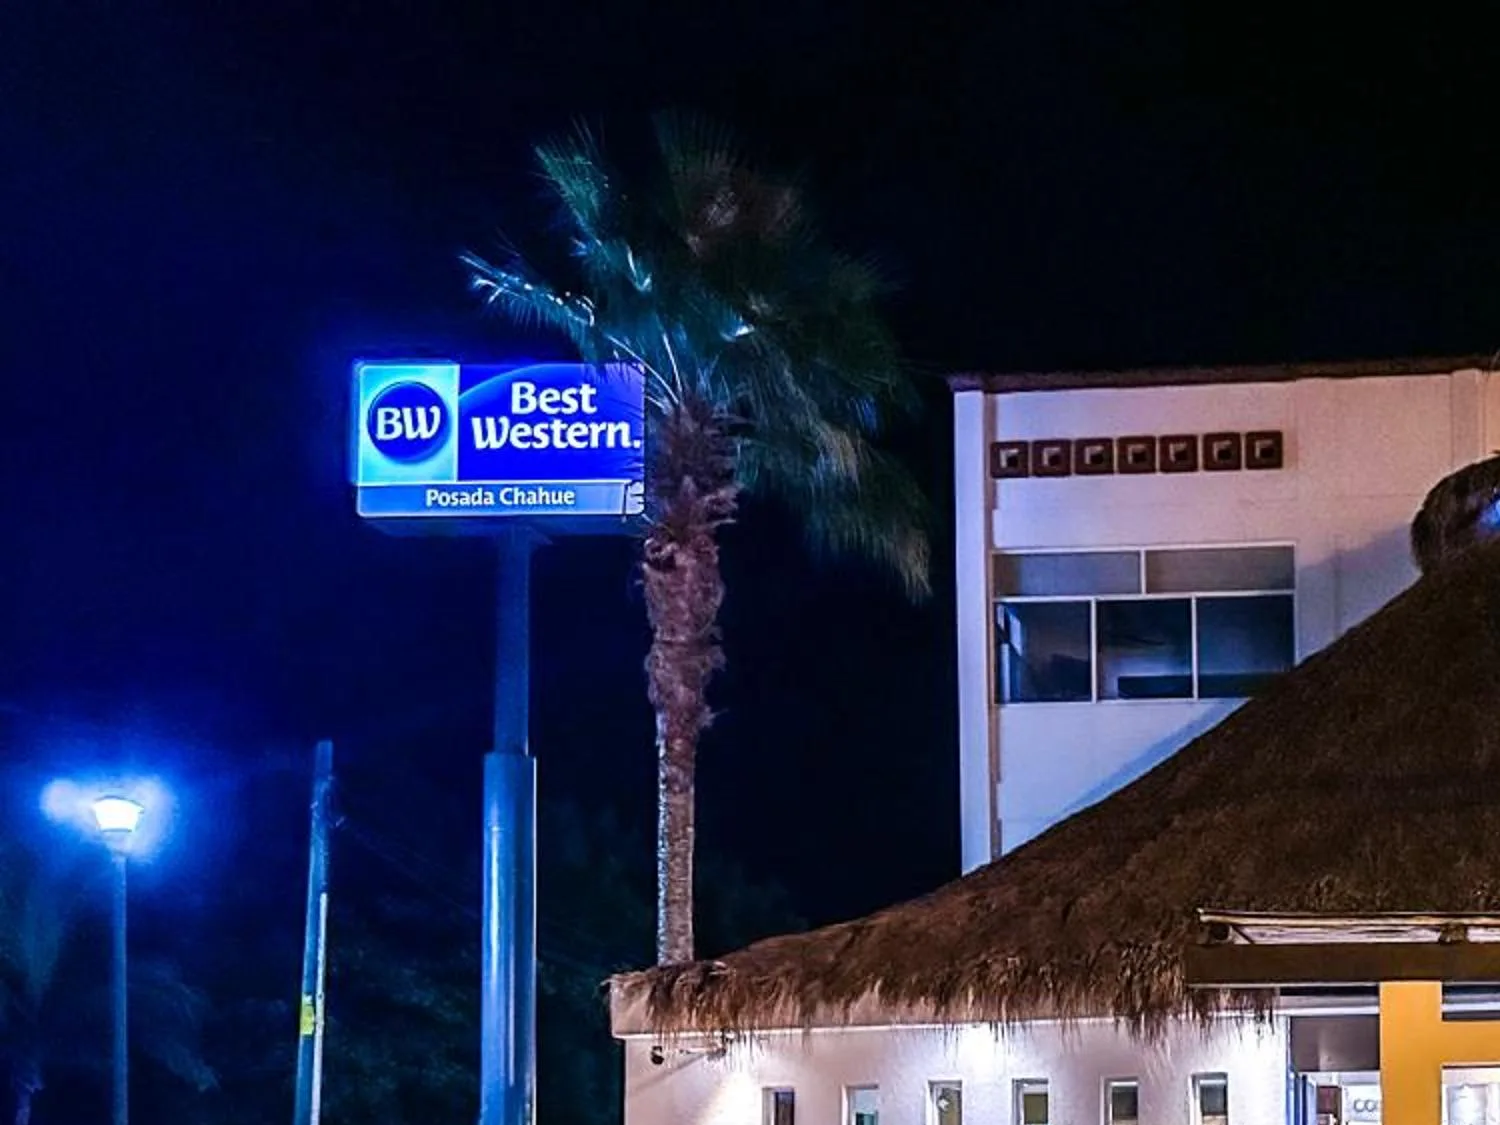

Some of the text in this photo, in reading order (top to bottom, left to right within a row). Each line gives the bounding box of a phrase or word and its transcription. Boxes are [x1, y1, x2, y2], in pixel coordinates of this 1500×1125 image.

[511, 381, 597, 415] Best
[376, 406, 441, 440] BW
[426, 488, 575, 507] Posada Chahue
